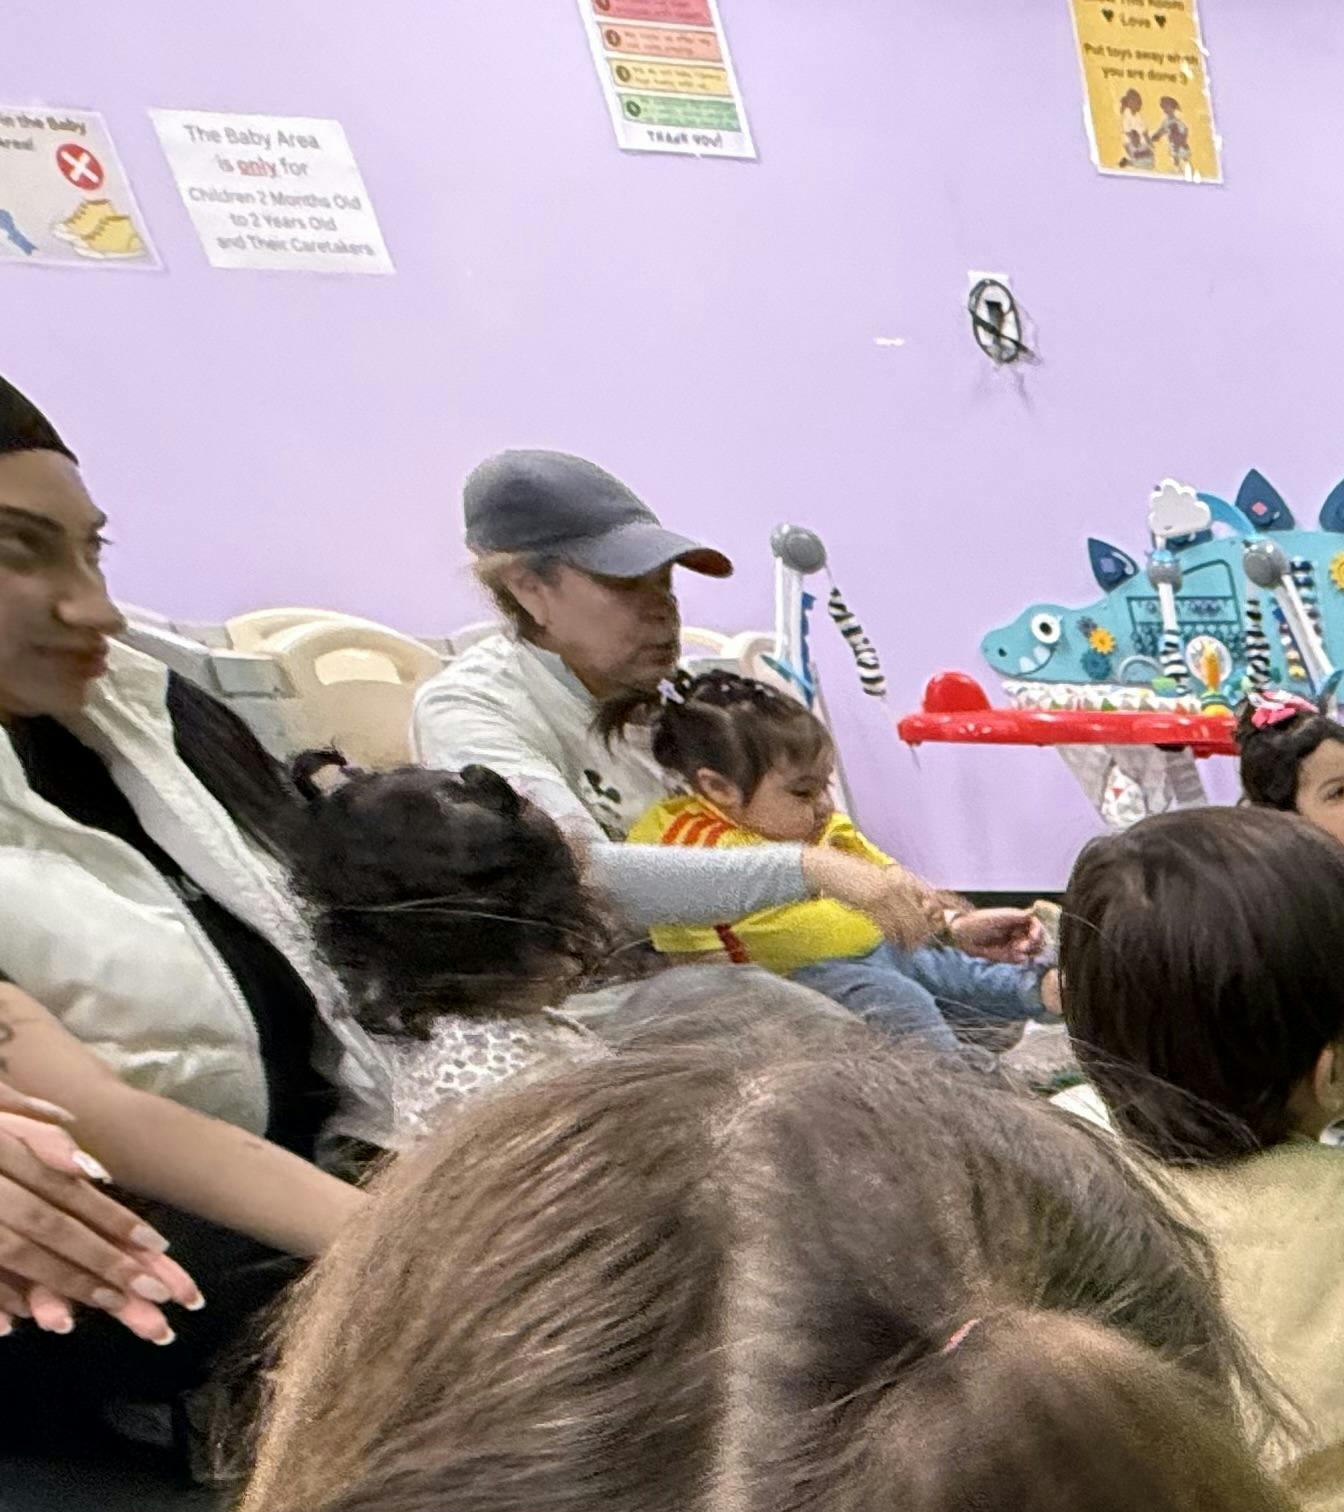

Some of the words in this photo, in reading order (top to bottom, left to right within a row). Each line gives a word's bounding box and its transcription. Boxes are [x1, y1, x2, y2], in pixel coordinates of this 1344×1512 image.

[1107, 46, 1132, 61] toys
[1135, 50, 1164, 65] away
[1101, 66, 1124, 79] you
[1148, 69, 1176, 82] done
[16, 114, 45, 129] the
[47, 116, 87, 136] Baby
[183, 124, 221, 143] The
[224, 127, 271, 150] Baby
[277, 130, 320, 149] Area
[215, 154, 234, 172] is
[237, 156, 277, 178] only
[279, 157, 308, 176] for
[188, 186, 255, 204] Children
[257, 191, 266, 205] 2
[269, 191, 331, 208] Months
[333, 193, 362, 210] Old
[230, 213, 247, 227] to
[249, 213, 259, 226] 2
[263, 215, 307, 229] Years
[309, 217, 337, 231] Old
[216, 235, 246, 249] and
[247, 235, 287, 251] Their
[291, 238, 376, 256] Caretakers
